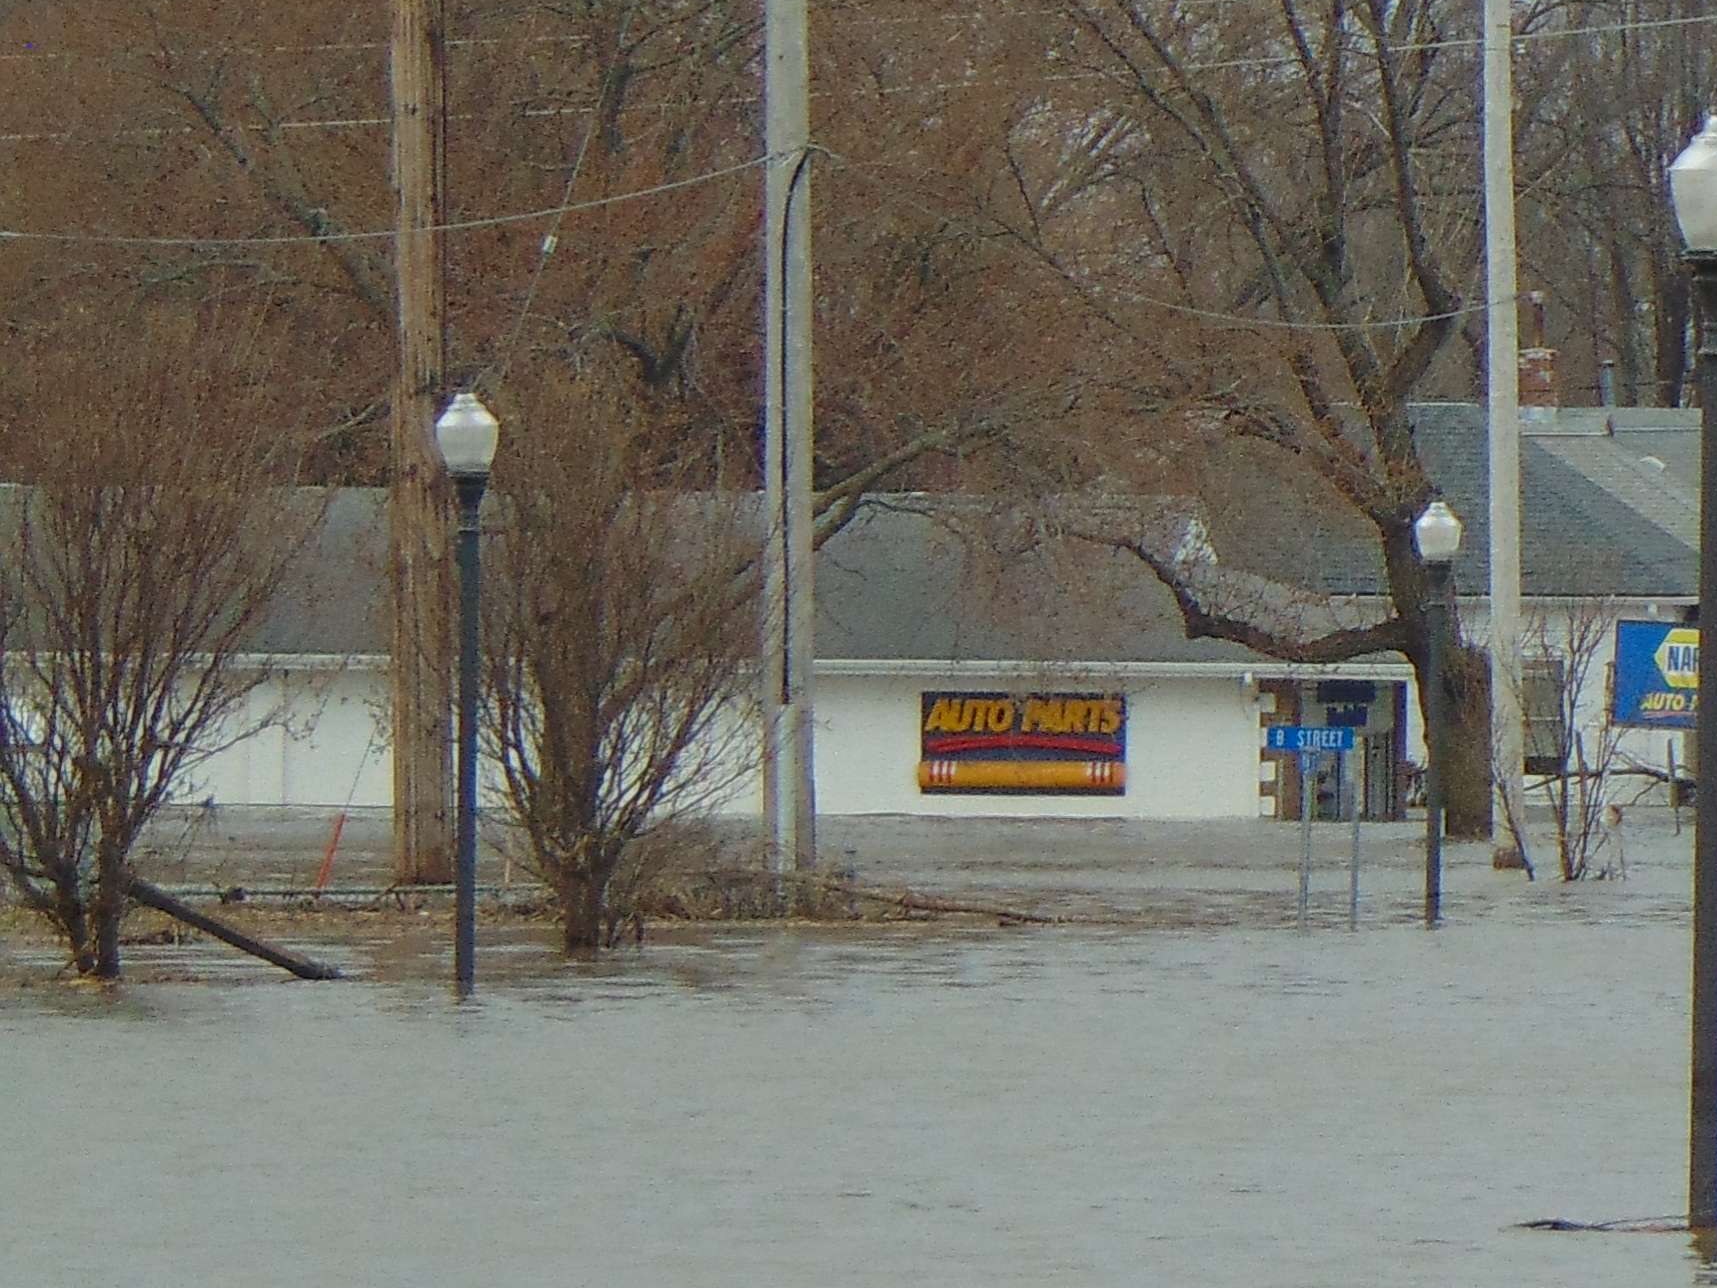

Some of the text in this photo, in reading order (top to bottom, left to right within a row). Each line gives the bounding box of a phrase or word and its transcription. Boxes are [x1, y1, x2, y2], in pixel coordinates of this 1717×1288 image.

[1639, 692, 1685, 711] AUTO
[925, 697, 1122, 734] AUTO PARTS
[1275, 729, 1344, 748] B STREET
